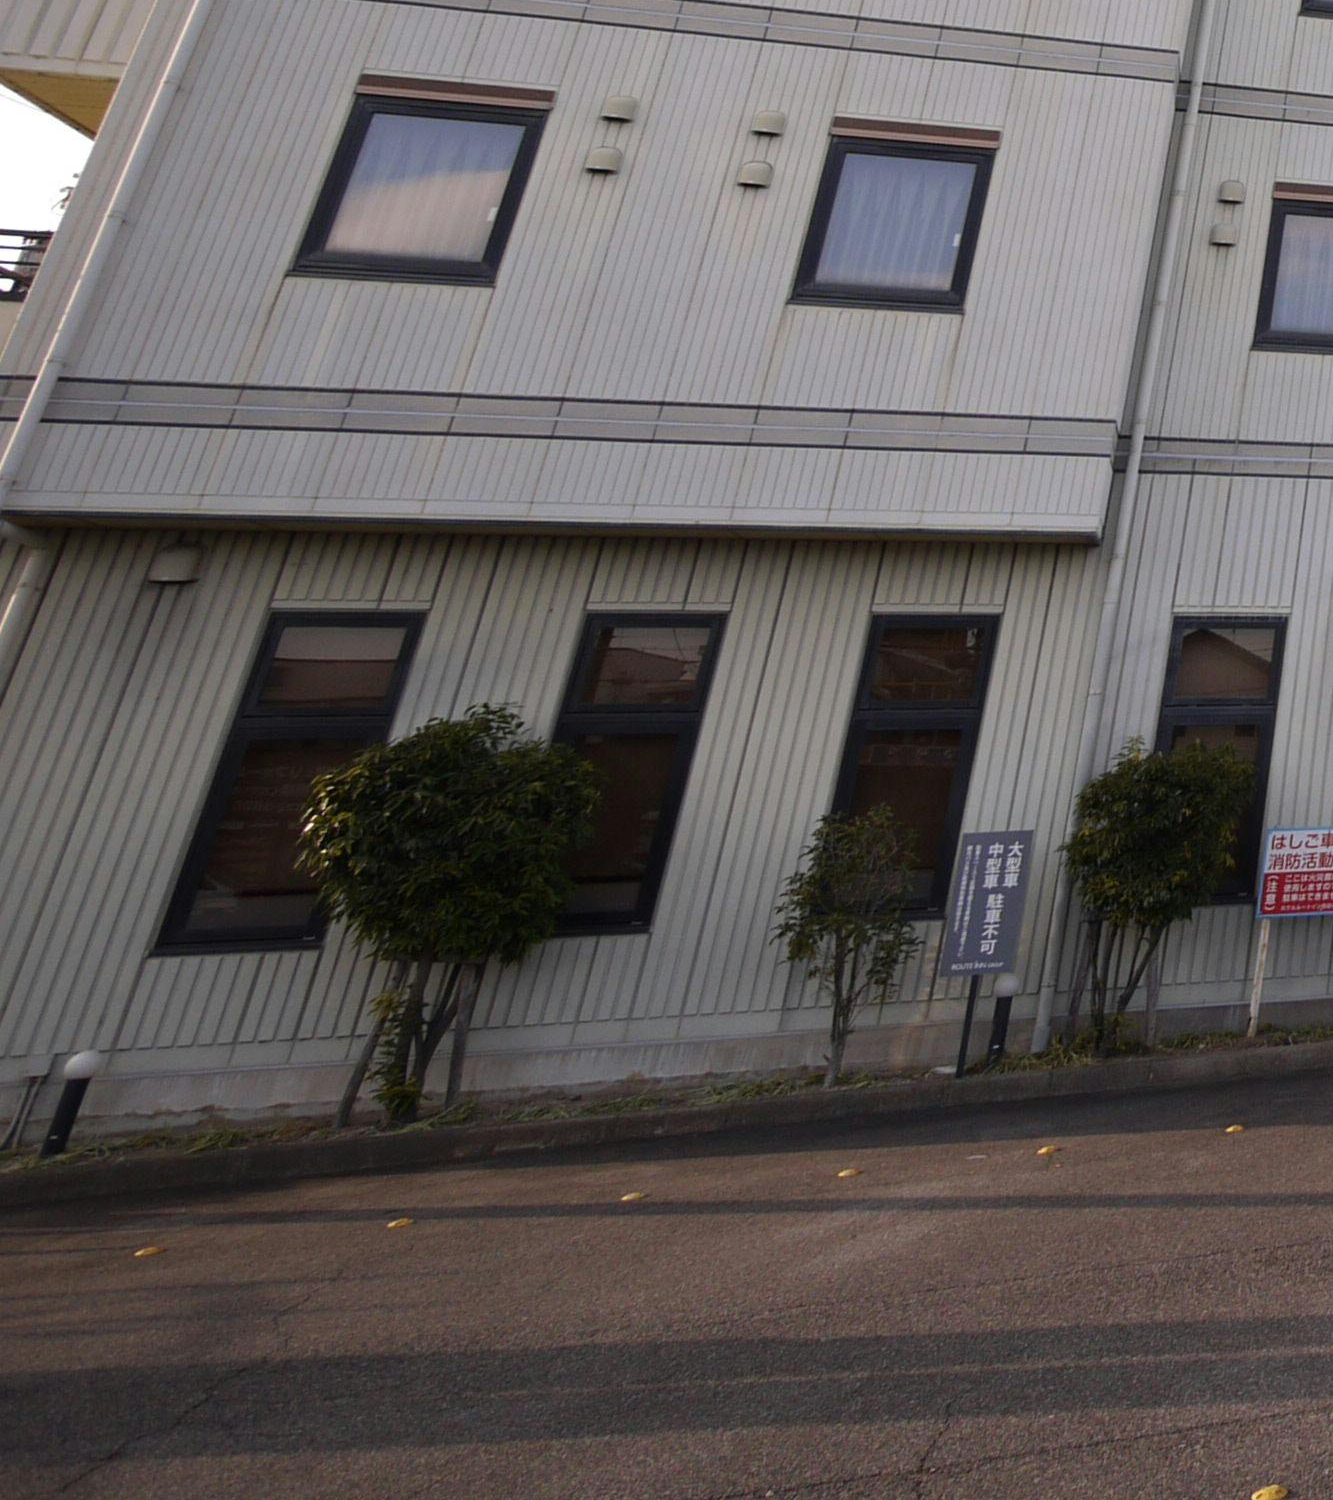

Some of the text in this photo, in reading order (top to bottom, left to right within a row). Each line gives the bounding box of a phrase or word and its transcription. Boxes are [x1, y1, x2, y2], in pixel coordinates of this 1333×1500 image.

[982, 842, 1004, 889] 中型車
[1003, 841, 1024, 888] 大型車
[980, 893, 1005, 955] 駐車不可
